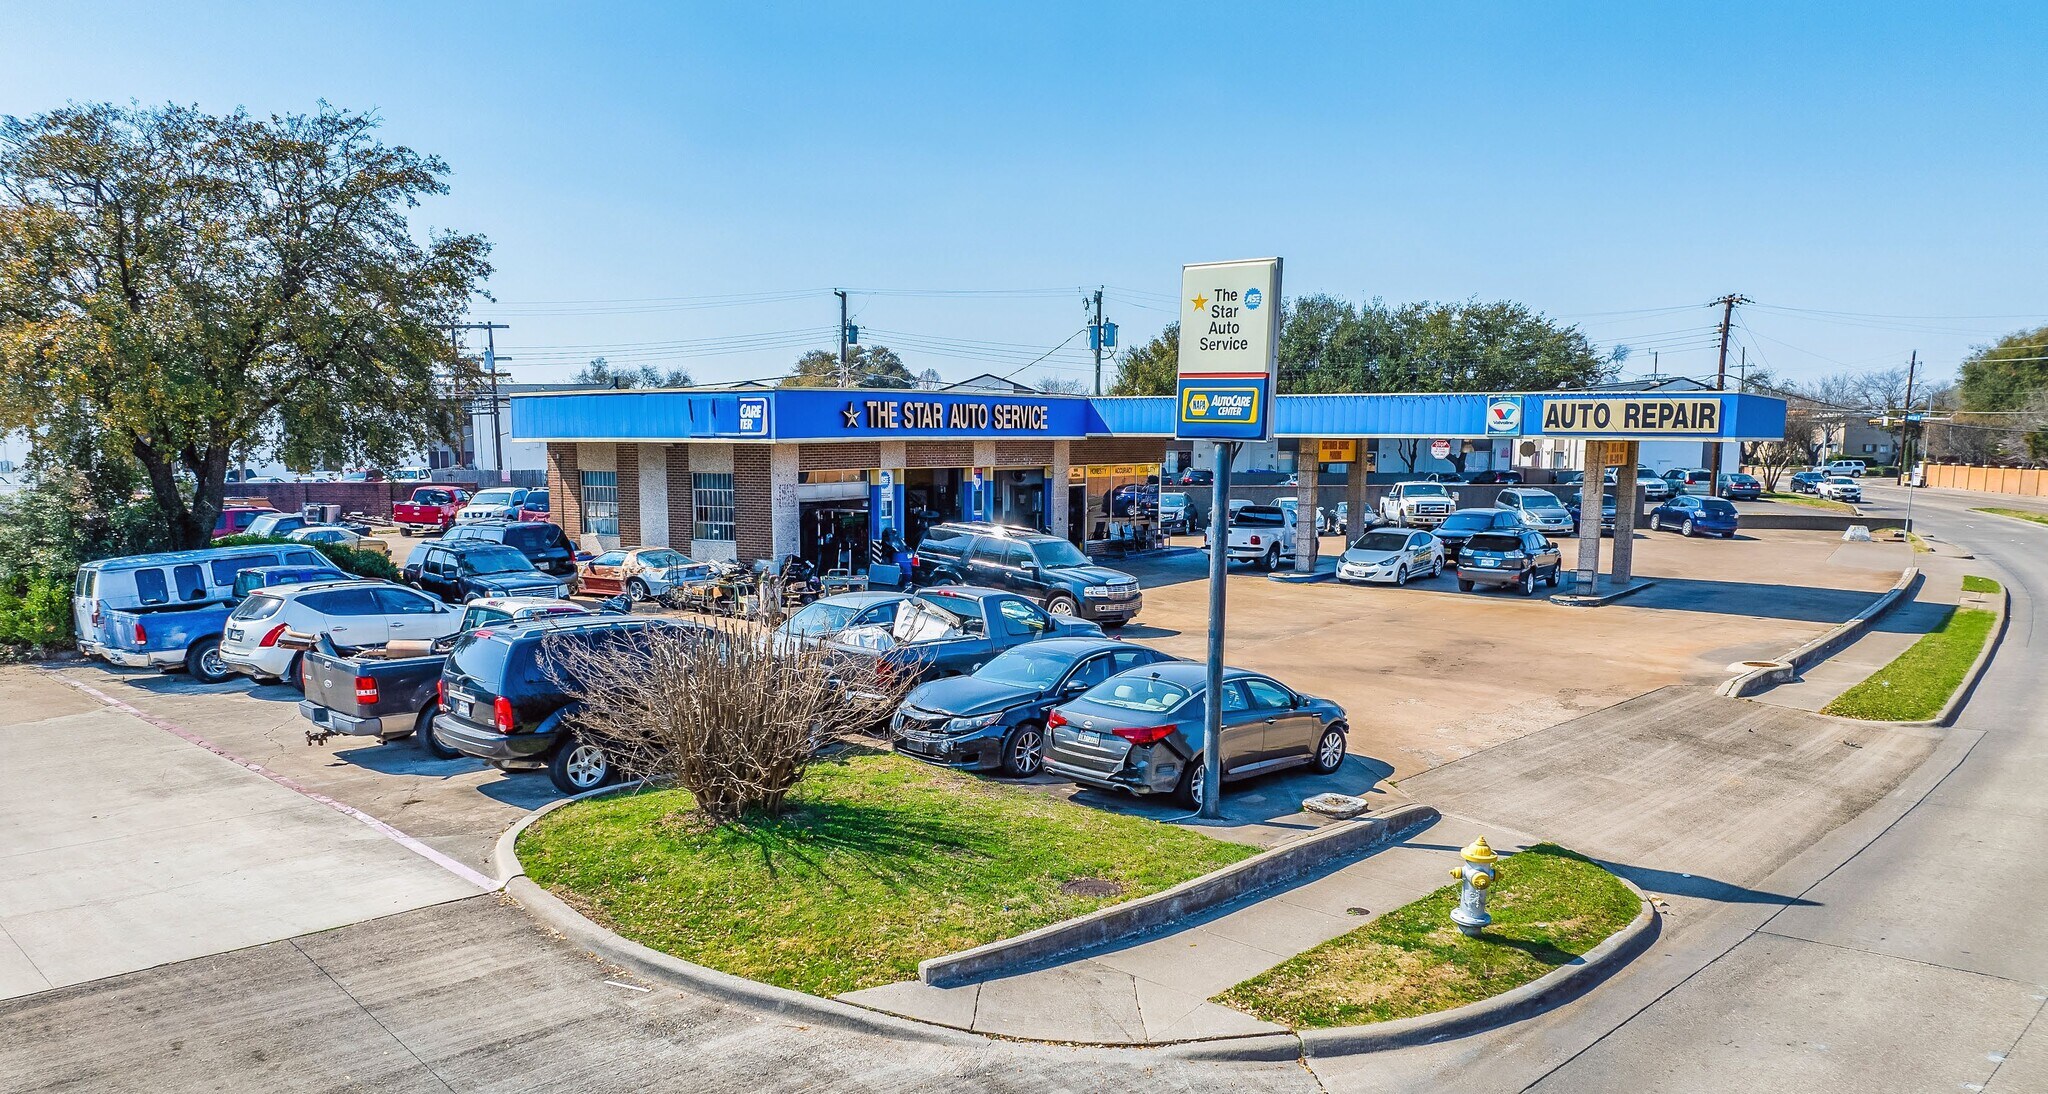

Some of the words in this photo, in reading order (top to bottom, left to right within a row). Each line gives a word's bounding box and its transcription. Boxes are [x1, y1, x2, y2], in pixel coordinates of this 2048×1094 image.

[1214, 288, 1238, 302] The
[1211, 304, 1239, 318] Star
[1208, 321, 1240, 335] Auto
[1199, 337, 1249, 351] Service
[739, 403, 762, 418] CARE
[1192, 400, 1206, 410] NAPA
[1217, 407, 1242, 416] CENTER
[866, 401, 898, 429] THE
[903, 402, 943, 429] STAR
[950, 403, 988, 430] AUTO
[994, 404, 1048, 430] SERVICE
[1543, 402, 1611, 429] AUTO
[1623, 402, 1716, 429] REPAIR
